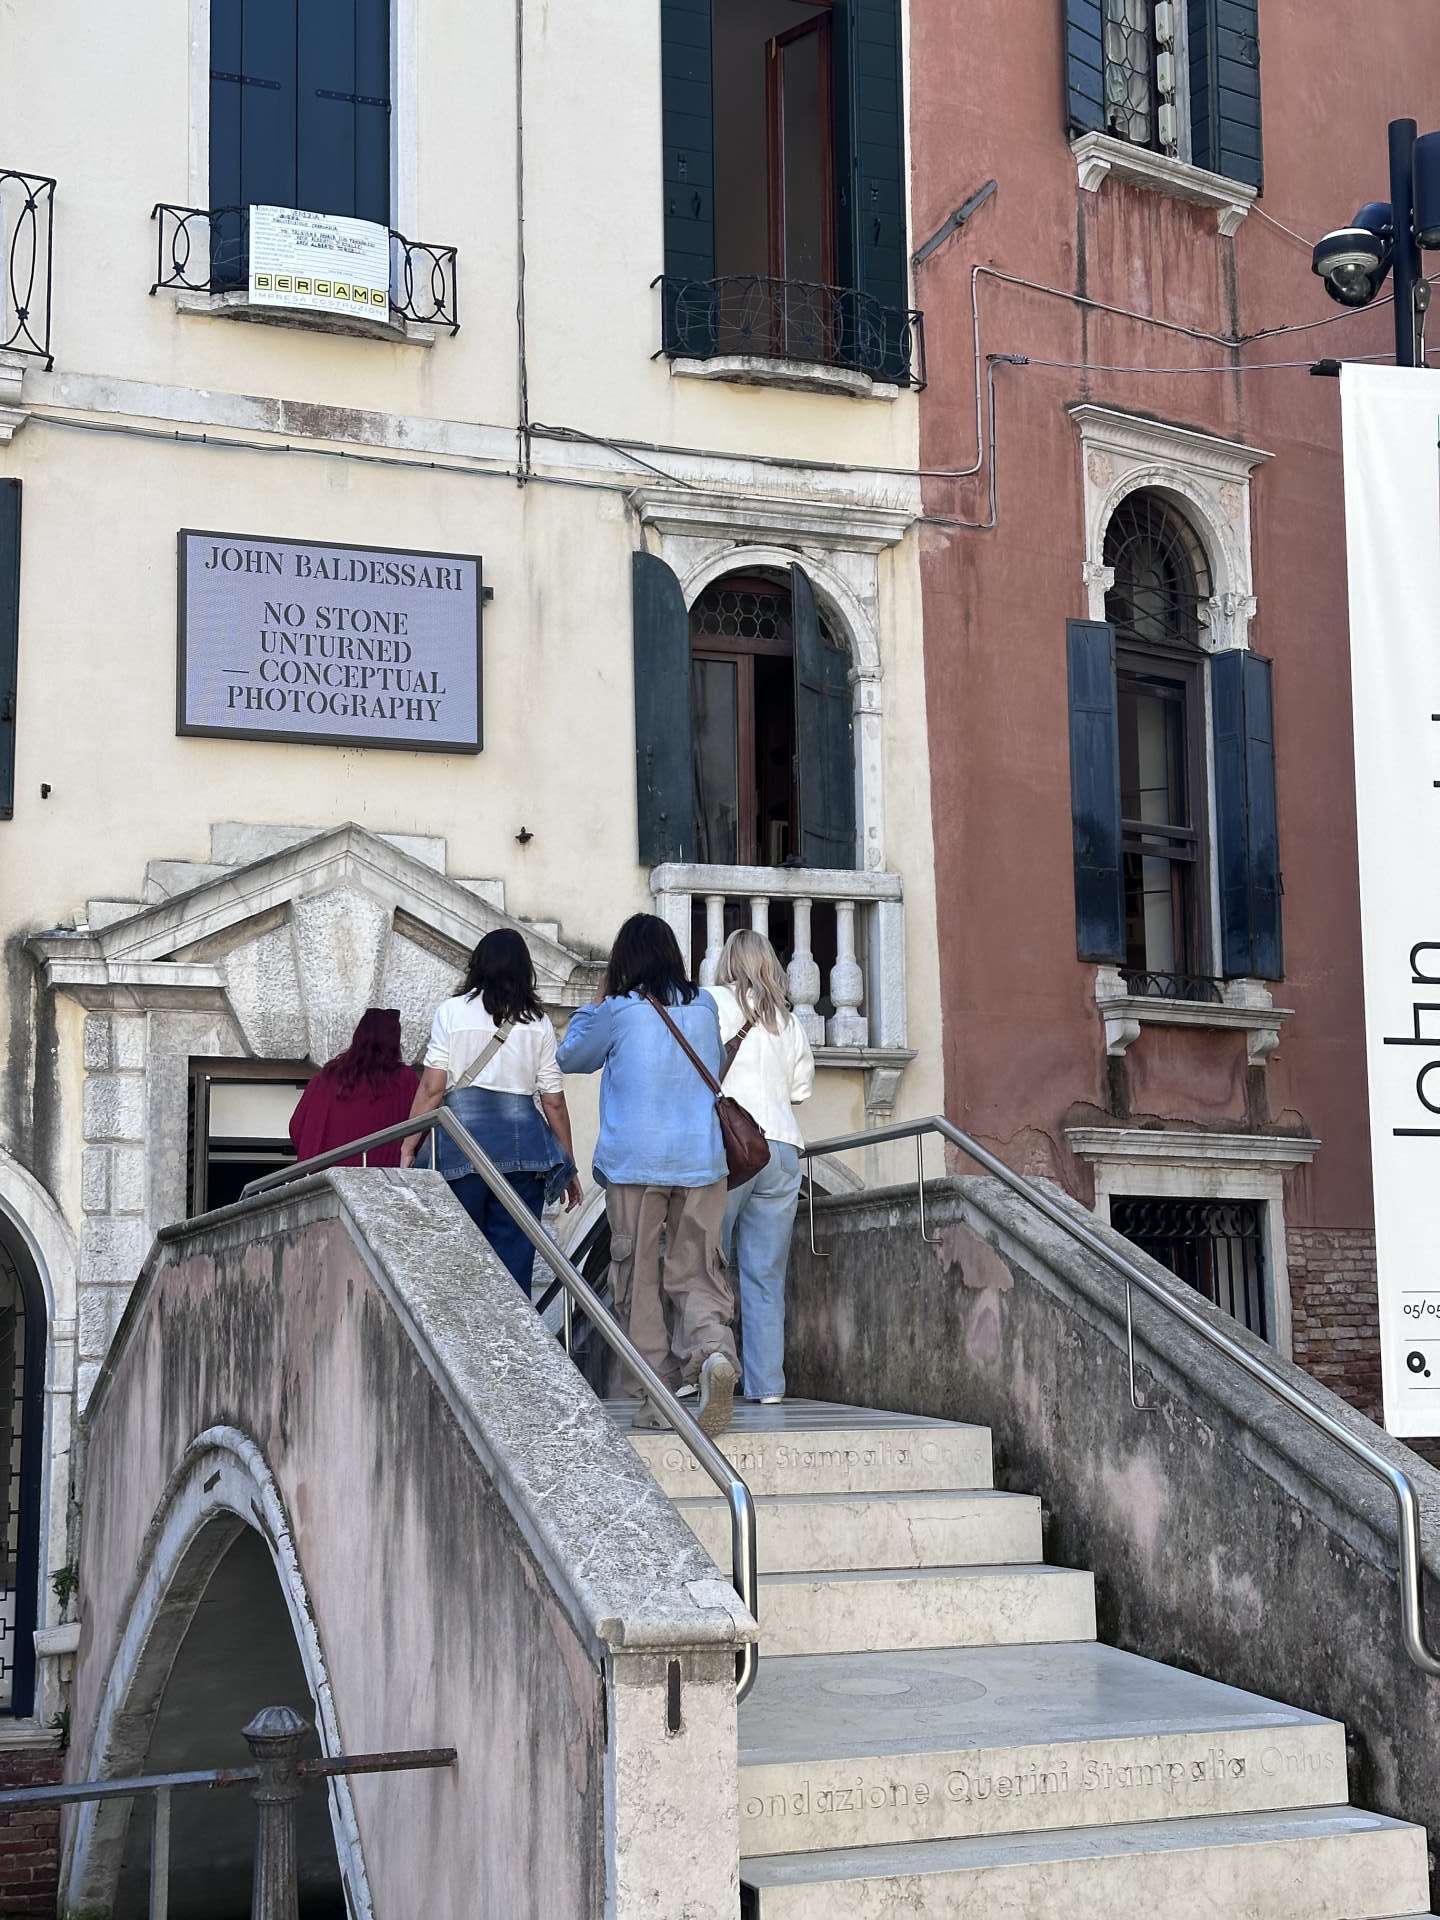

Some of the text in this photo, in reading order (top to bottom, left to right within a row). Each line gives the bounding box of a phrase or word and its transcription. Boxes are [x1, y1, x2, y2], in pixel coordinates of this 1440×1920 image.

[257, 276, 385, 304] BERGAMO
[204, 546, 464, 591] JOHN BALDESSARI
[263, 601, 408, 636] NO STONE
[259, 630, 412, 664] UNTURNED
[258, 658, 447, 695] CONCEPTUAL
[226, 684, 442, 722] PHOTOGRAPHY
[745, 1744, 1336, 1819] ondazione Querini Stampalia Onlus
